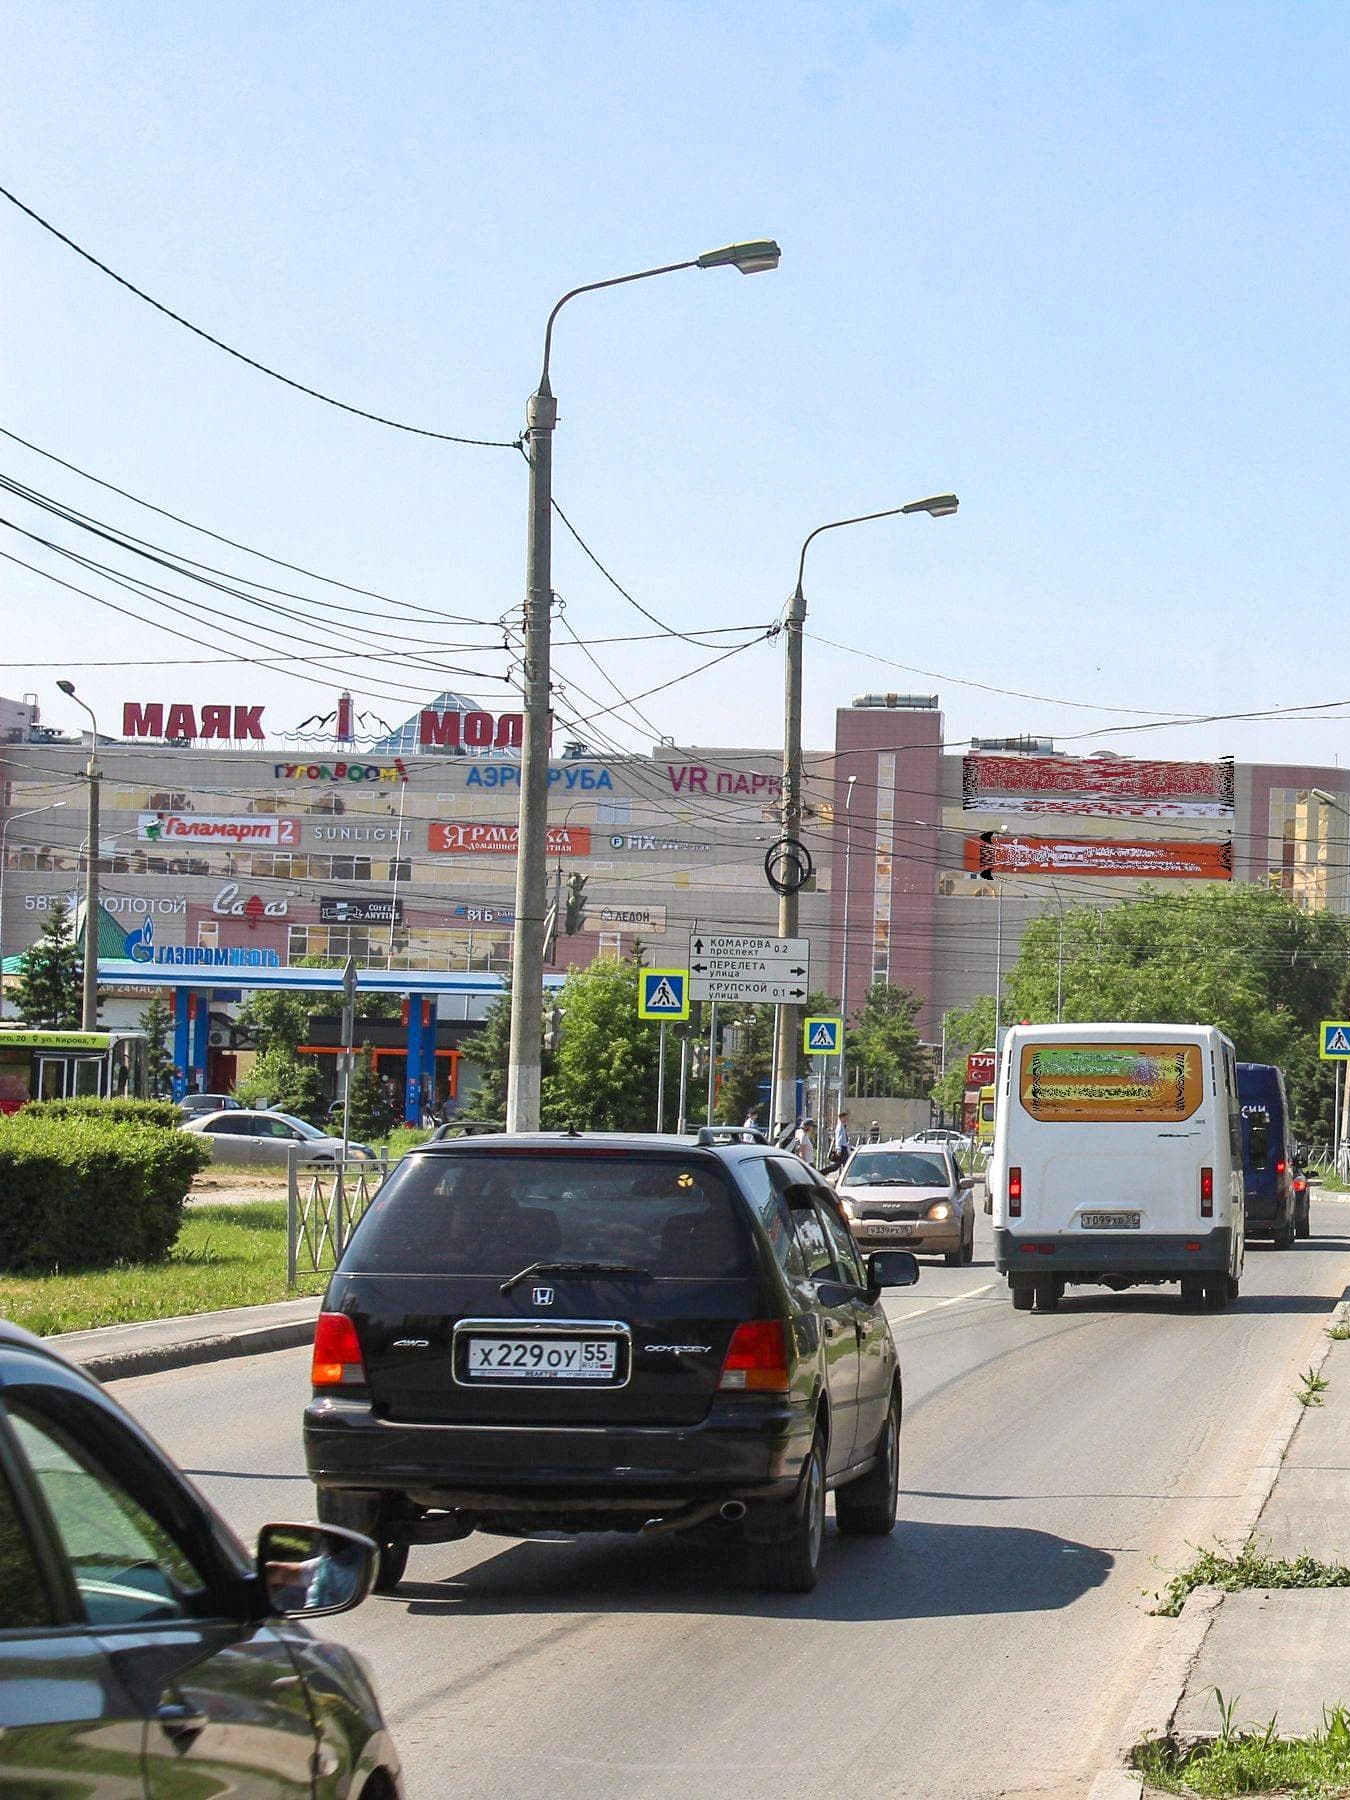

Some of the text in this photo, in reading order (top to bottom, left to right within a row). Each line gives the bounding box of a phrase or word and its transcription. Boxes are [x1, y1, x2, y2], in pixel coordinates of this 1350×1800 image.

[123, 702, 553, 748] МАЯК МОЛ
[466, 766, 613, 789] АЭРРУБА
[668, 767, 783, 795] VR ПАРК
[165, 817, 294, 842] Галамарт 2
[314, 827, 412, 842] SUNLIGHT
[469, 842, 519, 851] домашнег
[369, 904, 395, 912] COFFE
[710, 939, 771, 949] КОМАРОВА
[159, 945, 280, 967] ГАЗПРОМНЕФТЬ
[710, 948, 759, 956] проспект
[709, 961, 766, 970] ПЕРЕЛЕТА
[709, 970, 740, 978] улица
[709, 982, 767, 992] КРУПСКОЙ
[709, 992, 739, 1000] улица
[970, 1057, 996, 1067] ТУР
[584, 1343, 607, 1361] 55
